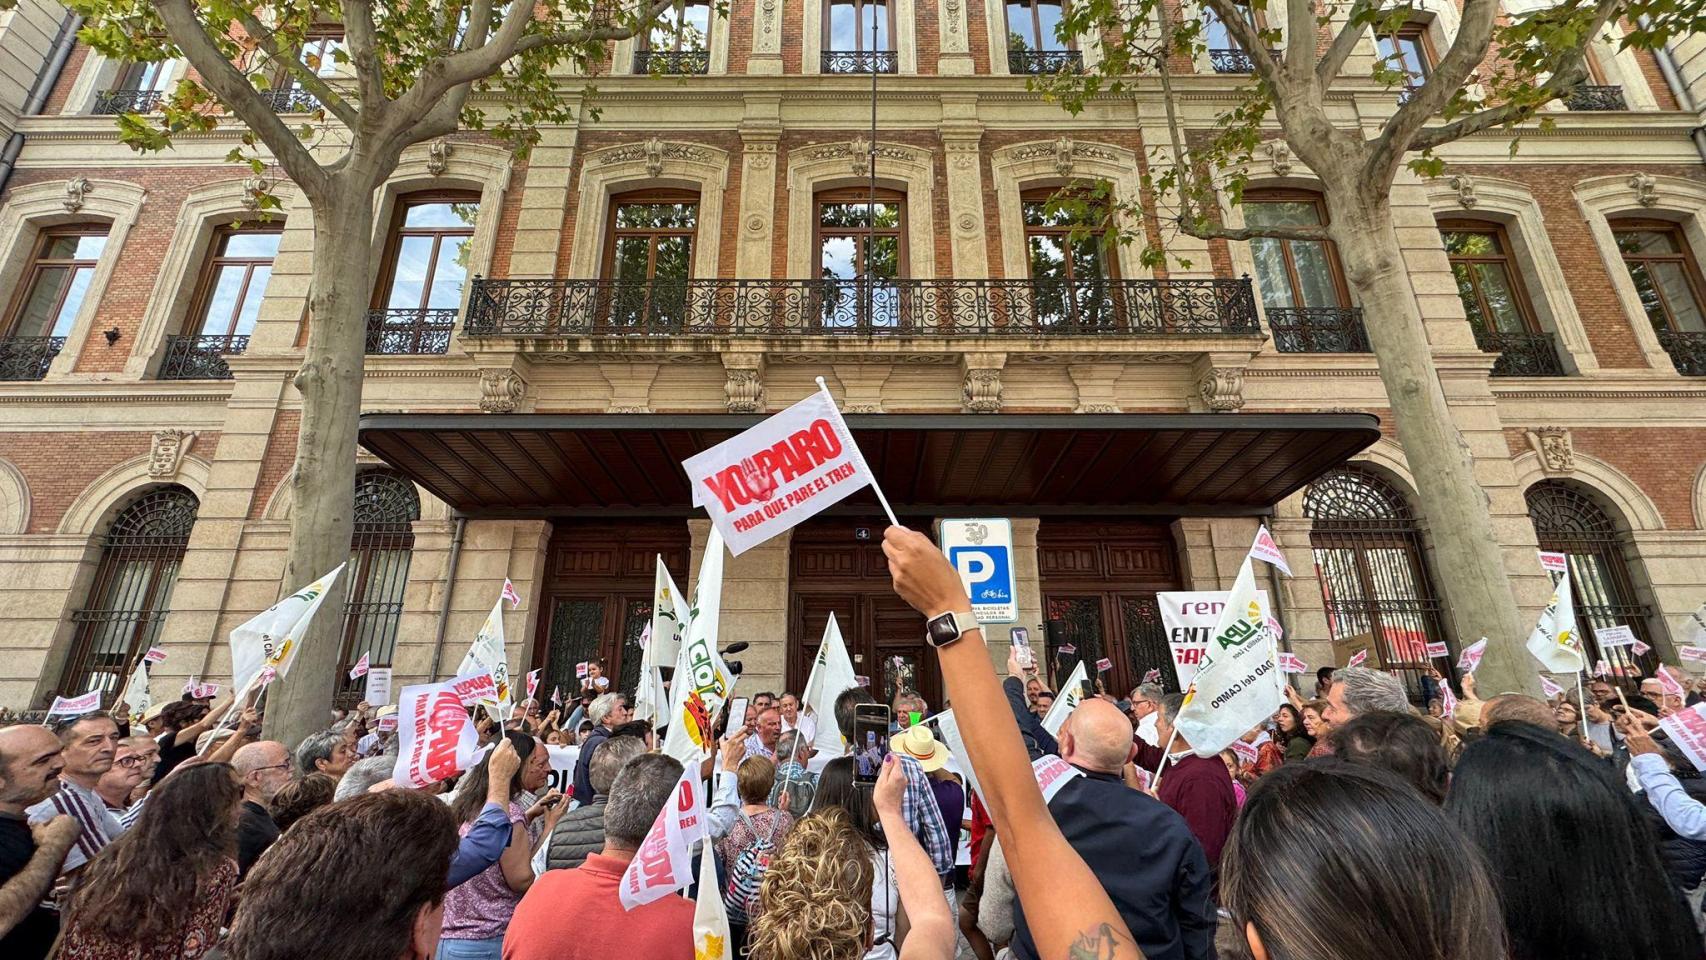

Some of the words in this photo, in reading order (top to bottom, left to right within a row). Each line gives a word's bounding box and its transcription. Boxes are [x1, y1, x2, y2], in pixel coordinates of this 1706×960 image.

[752, 418, 842, 492] PARO
[733, 514, 766, 533] PARA
[763, 498, 788, 520] QUE
[787, 483, 818, 508] PARE
[813, 476, 829, 492] EL
[825, 461, 857, 486] TREN
[956, 551, 996, 599] P
[1171, 626, 1214, 643] ENT
[415, 719, 427, 738] QUE
[410, 738, 424, 766] PARE
